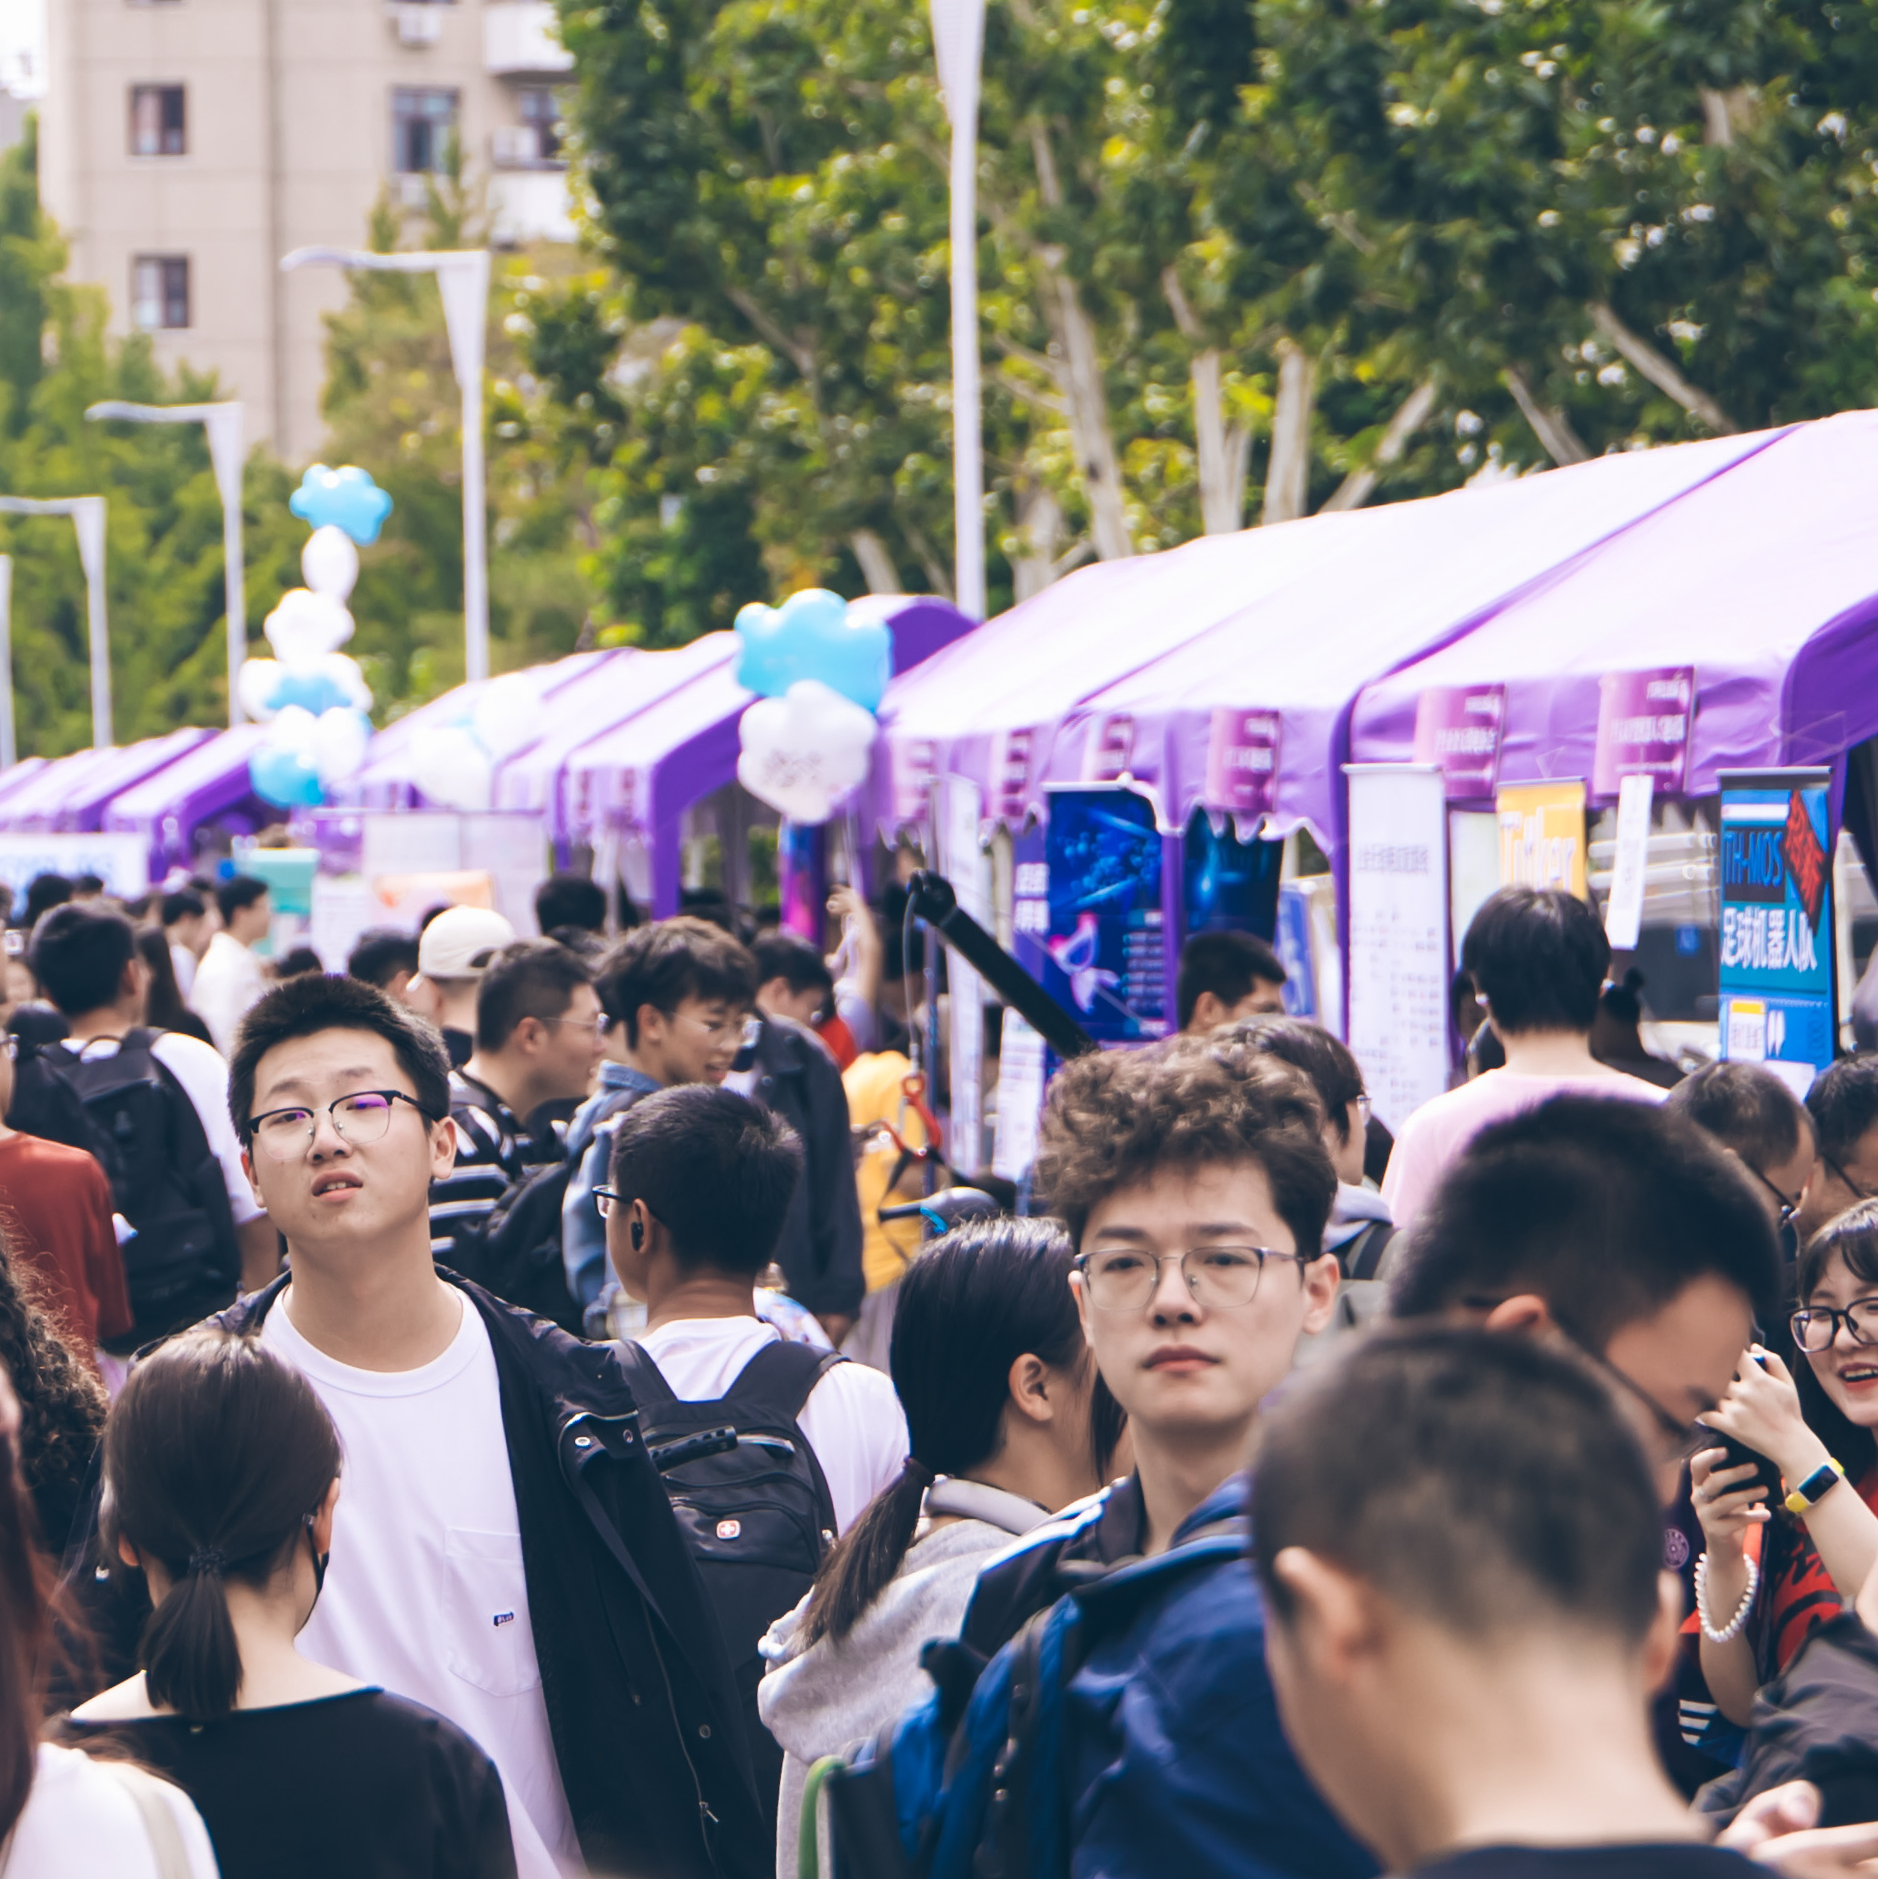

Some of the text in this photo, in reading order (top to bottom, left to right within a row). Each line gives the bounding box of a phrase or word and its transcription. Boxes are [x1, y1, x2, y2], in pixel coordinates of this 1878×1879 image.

[1723, 829, 1784, 888] TH-MOS
[1720, 906, 1818, 973] 足球机器人队
